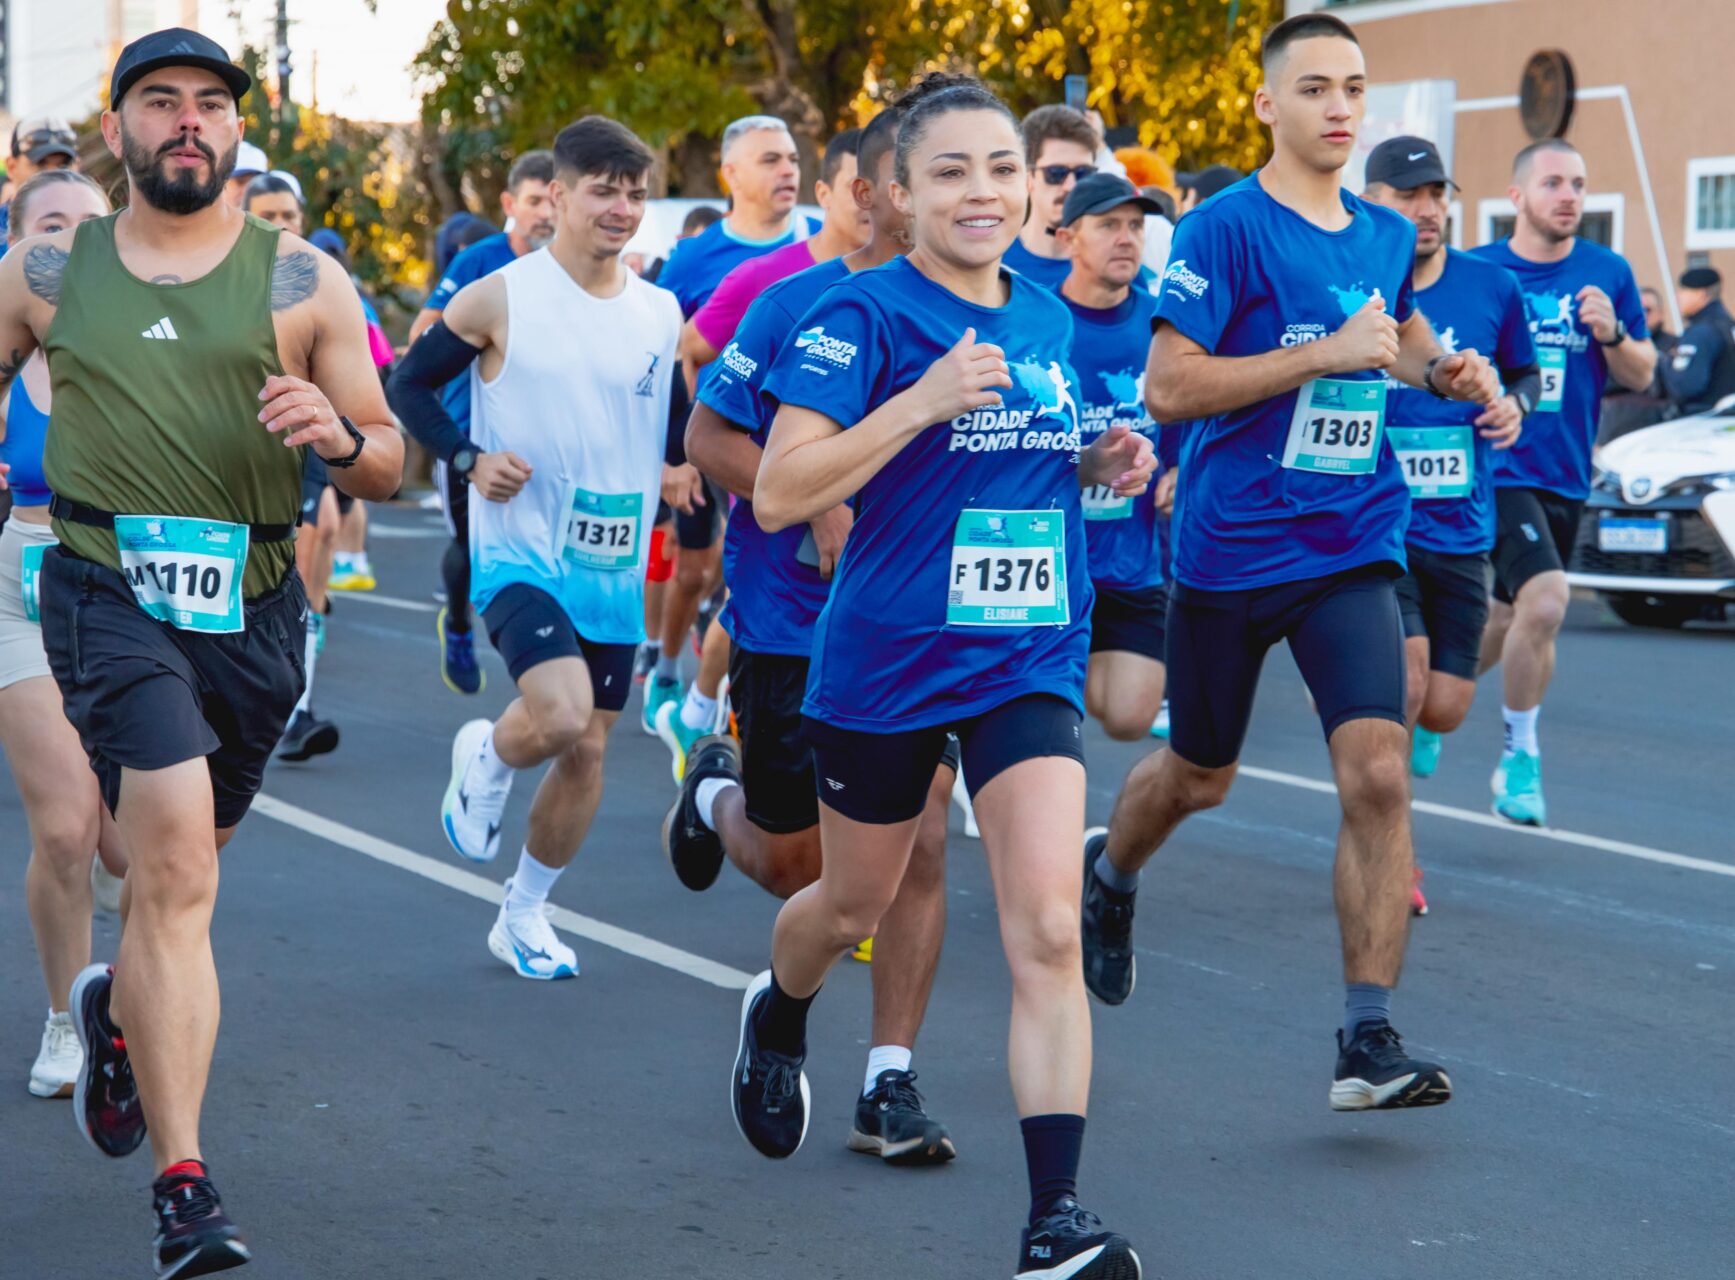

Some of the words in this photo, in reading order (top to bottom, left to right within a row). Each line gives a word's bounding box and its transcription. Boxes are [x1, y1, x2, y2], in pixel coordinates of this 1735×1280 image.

[1180, 266, 1209, 290] PONTA
[1285, 324, 1326, 333] CORRIDA
[816, 334, 858, 357] PONTA
[1280, 332, 1337, 348] CID
[732, 350, 758, 373] PONTA
[806, 344, 852, 366] GROSSA
[950, 410, 1034, 432] CIDADE
[948, 431, 1019, 453] PONTA
[1311, 417, 1373, 448] 1303
[1406, 456, 1460, 477] 1012
[577, 520, 630, 547] 1312
[124, 566, 146, 587] M
[145, 562, 221, 600] 1110
[955, 564, 967, 585] F
[974, 558, 1050, 592] 1376
[1030, 1245, 1051, 1258] FILA
